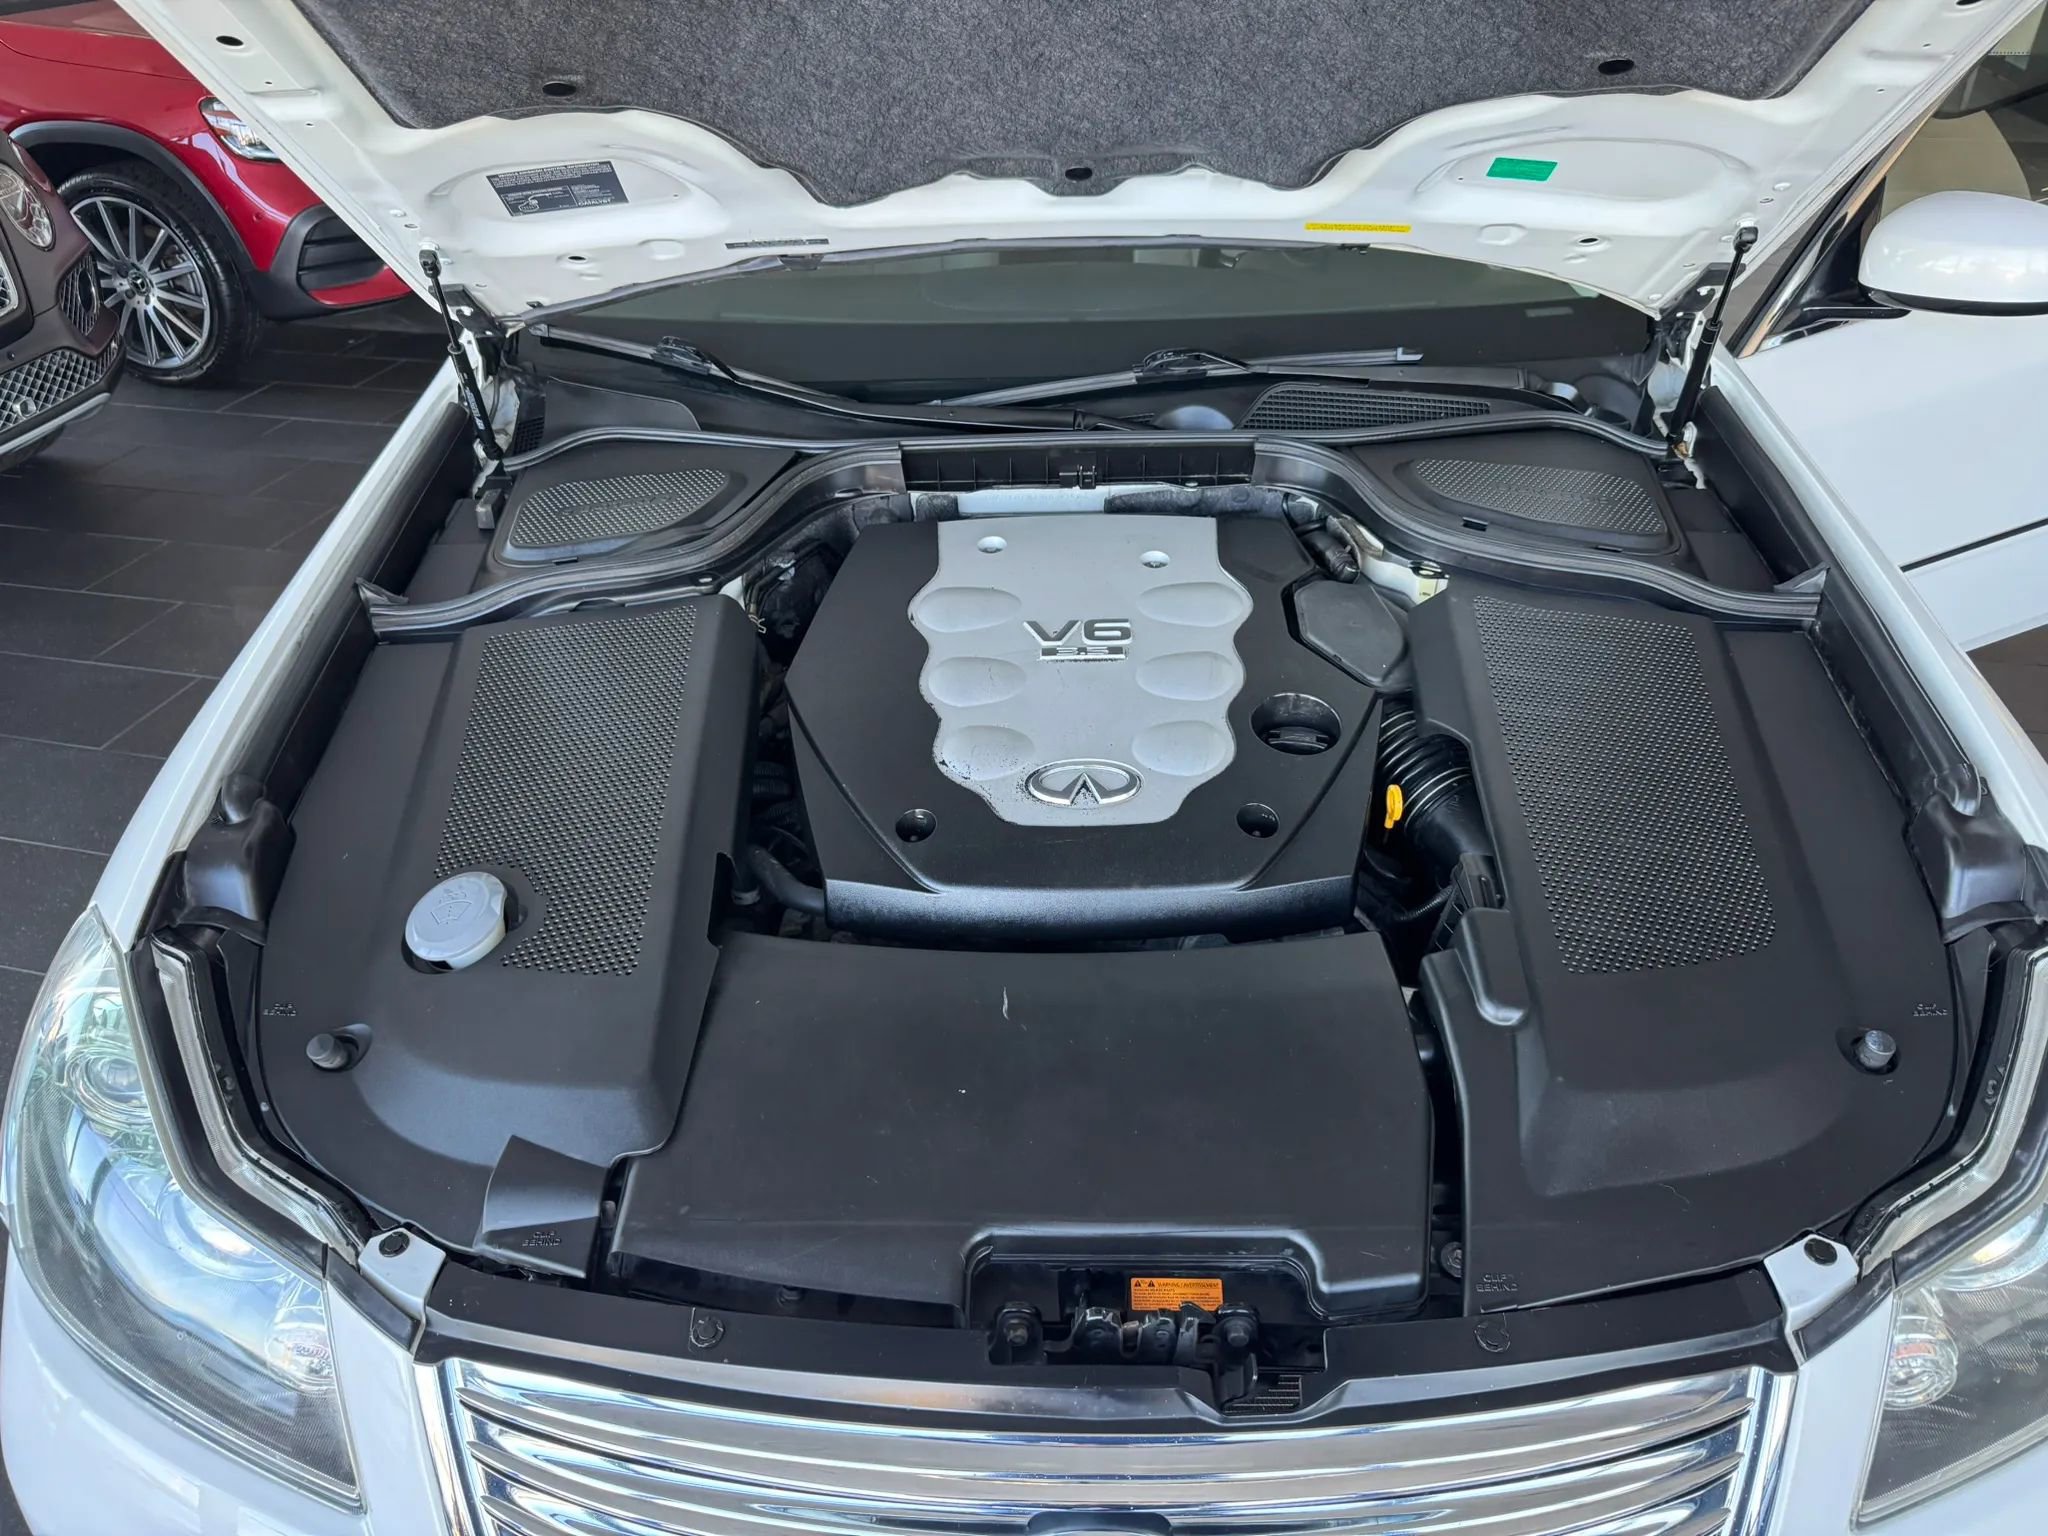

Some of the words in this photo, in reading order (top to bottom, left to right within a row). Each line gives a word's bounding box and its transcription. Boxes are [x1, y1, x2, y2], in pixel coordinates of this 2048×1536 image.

[1022, 618, 1132, 646] V6
[1483, 1273, 1507, 1283] CLIP
[1476, 1283, 1518, 1292] BEHIND
